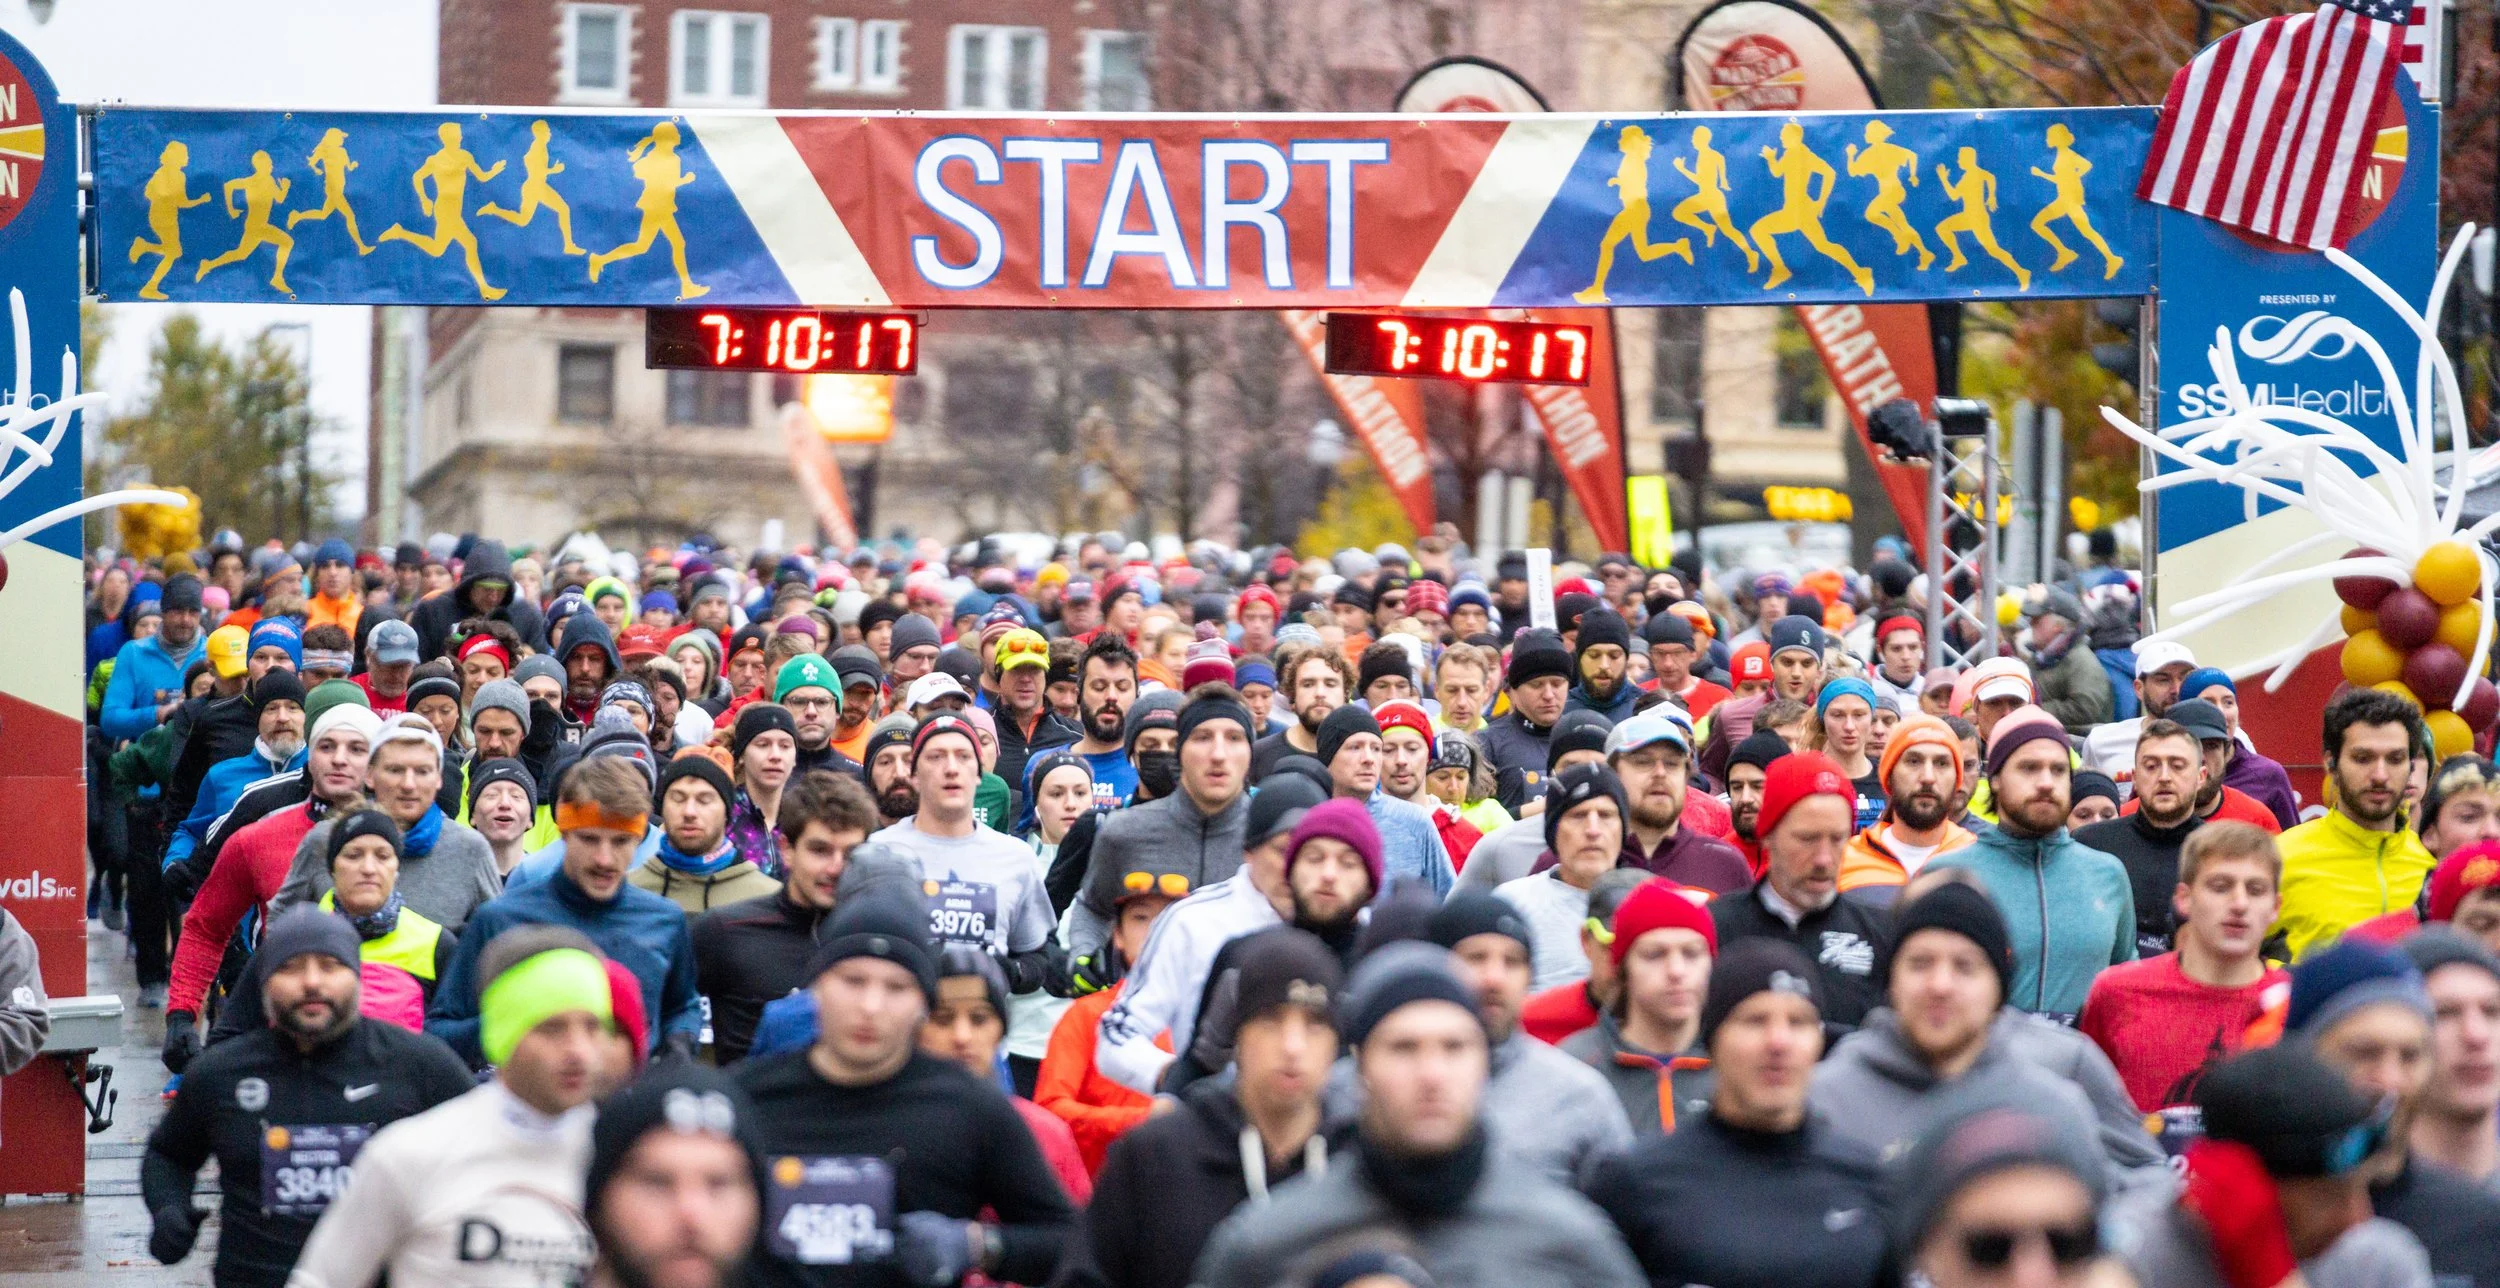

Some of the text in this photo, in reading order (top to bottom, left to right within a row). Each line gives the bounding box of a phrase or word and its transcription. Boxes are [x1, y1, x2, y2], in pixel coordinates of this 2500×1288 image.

[911, 134, 1389, 289] START
[2259, 294, 2336, 304] PRESENTED BY
[701, 314, 912, 370] 7:10:17
[1377, 320, 1586, 380] 7:10:17
[929, 909, 986, 937] 3976
